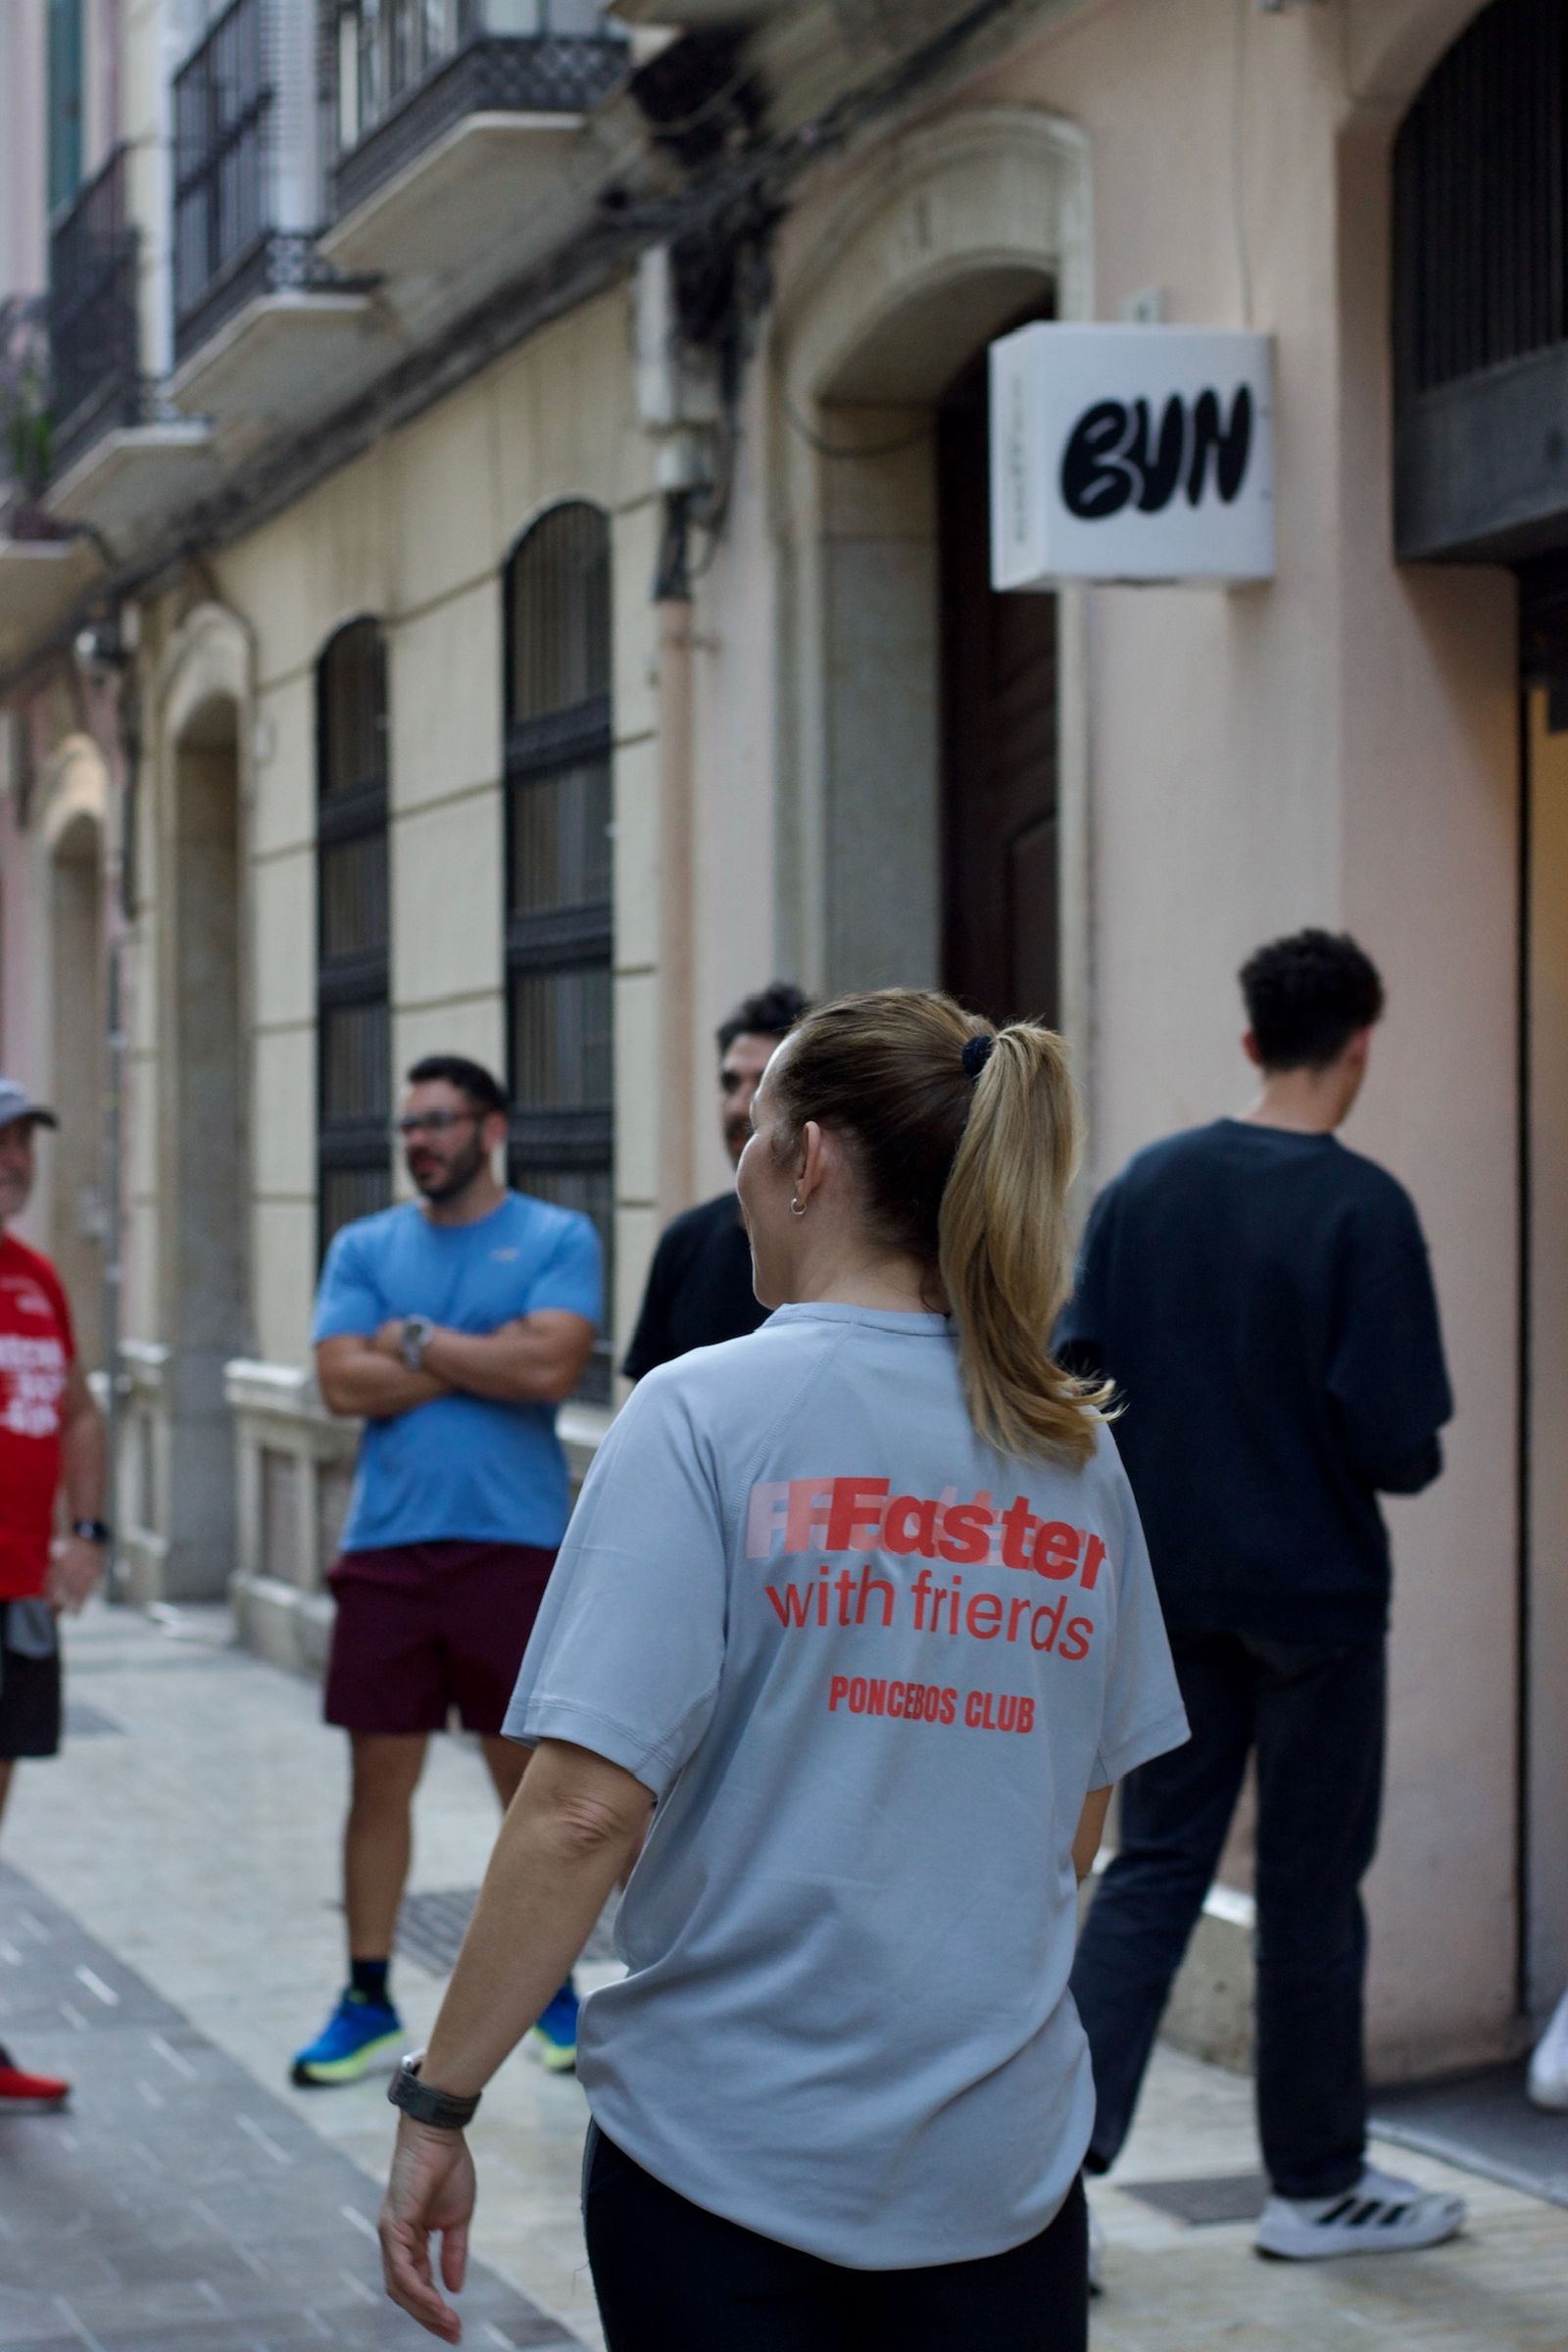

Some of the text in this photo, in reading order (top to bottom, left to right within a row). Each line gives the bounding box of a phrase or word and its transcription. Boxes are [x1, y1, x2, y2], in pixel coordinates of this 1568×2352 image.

[1061, 383, 1251, 519] BUN
[764, 1565, 895, 1628] with
[828, 1675, 1035, 1734] PONCEBOS CLUB
